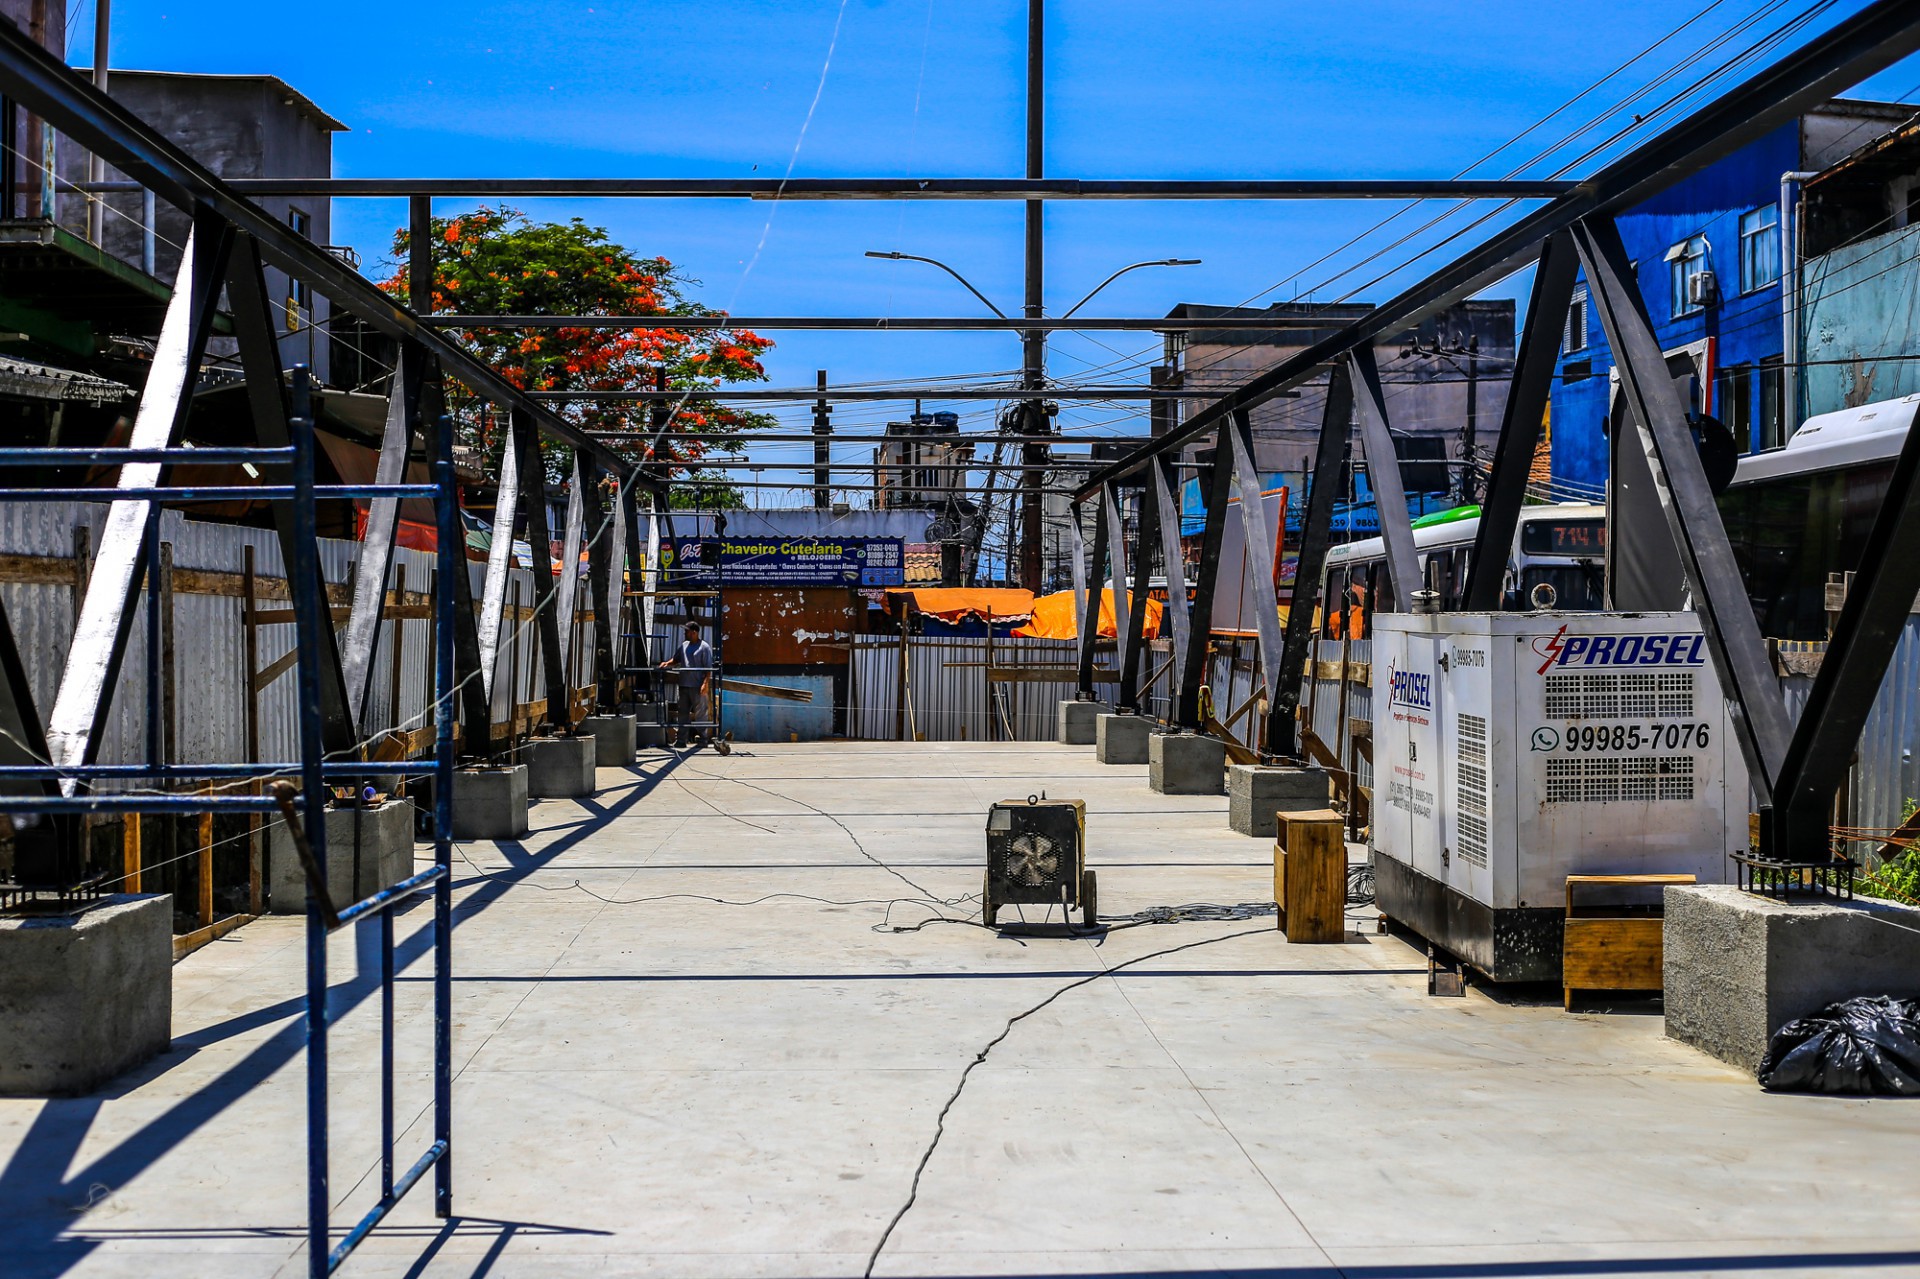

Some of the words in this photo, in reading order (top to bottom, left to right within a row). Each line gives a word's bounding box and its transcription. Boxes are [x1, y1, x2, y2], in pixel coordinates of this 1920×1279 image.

[721, 542, 777, 555] Chaveiro
[780, 542, 843, 555] Cutelaria
[1553, 527, 1589, 546] 714
[1557, 635, 1706, 666] PROSEL
[1393, 671, 1431, 707] PROSEL
[1565, 723, 1710, 752] 99985-7076
